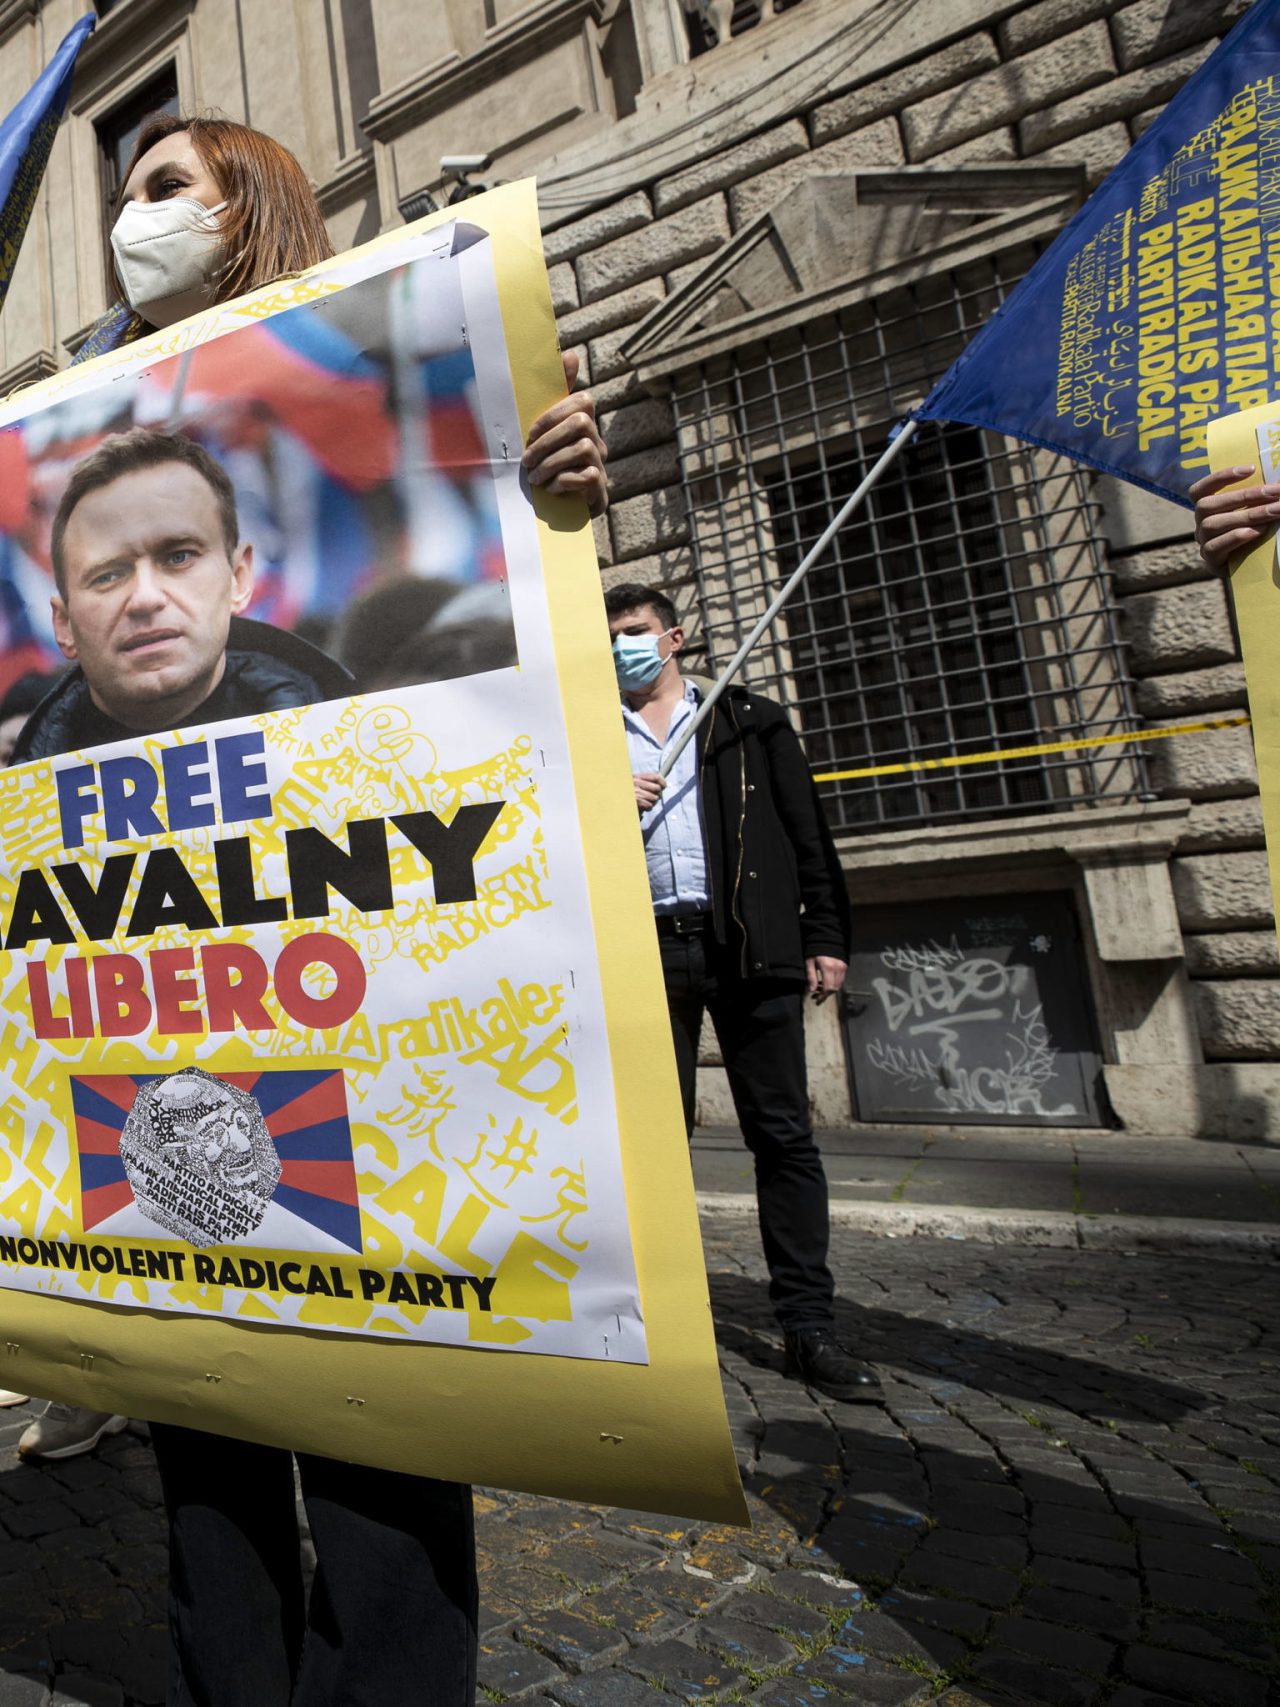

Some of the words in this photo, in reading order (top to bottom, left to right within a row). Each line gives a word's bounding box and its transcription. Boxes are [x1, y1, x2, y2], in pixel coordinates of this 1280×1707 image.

[1225, 341, 1268, 411] ПАР
[55, 731, 272, 849] FREE
[25, 931, 367, 1040] LIBERO
[195, 1254, 354, 1299] RADICAL
[361, 1268, 497, 1312] PARTY
